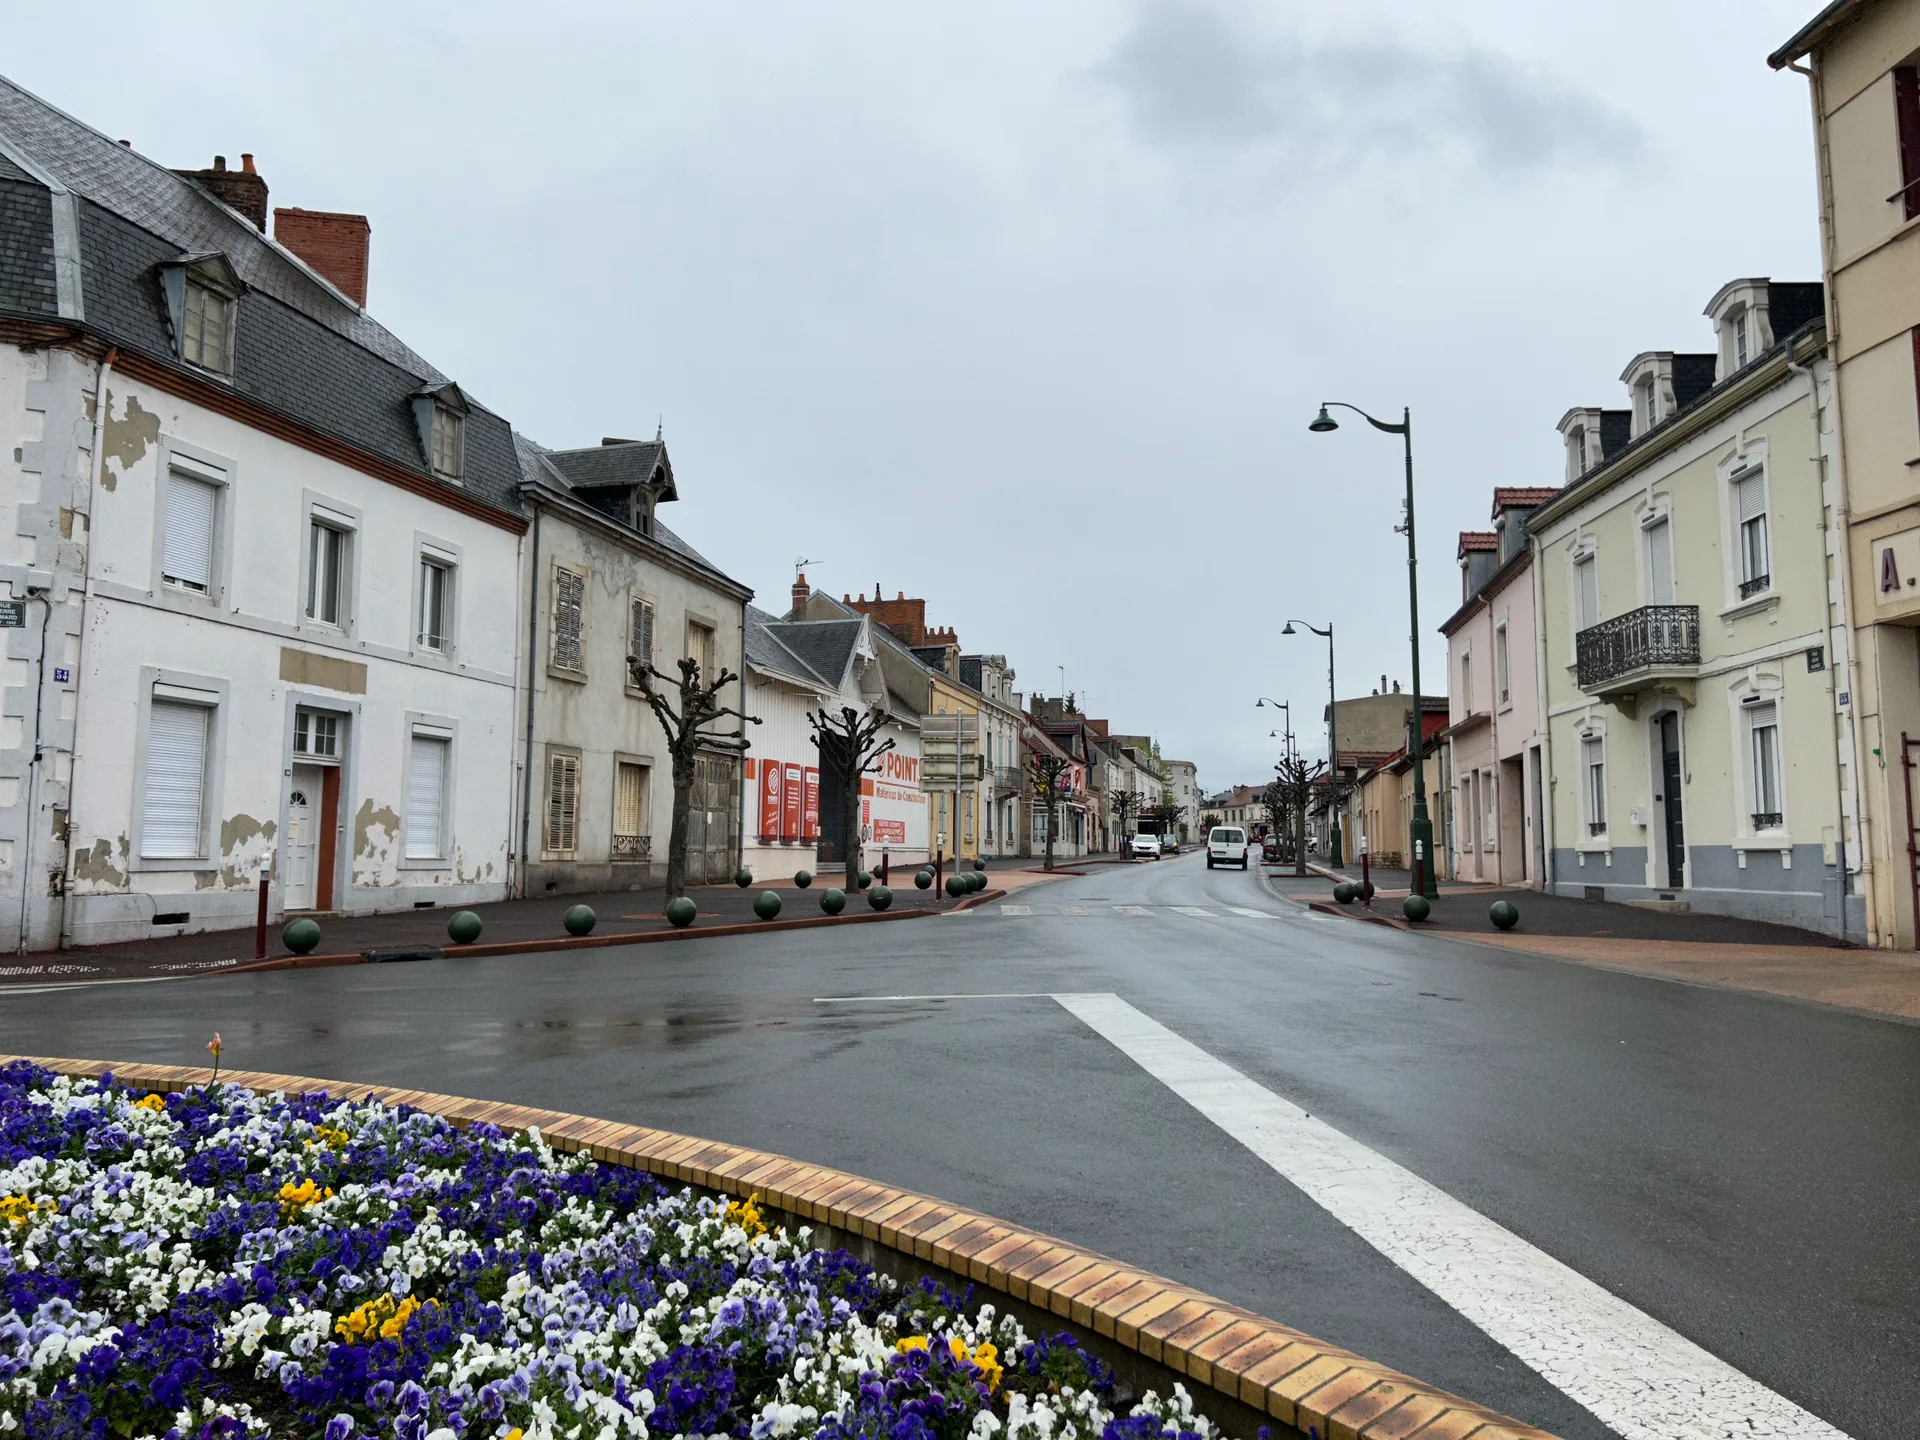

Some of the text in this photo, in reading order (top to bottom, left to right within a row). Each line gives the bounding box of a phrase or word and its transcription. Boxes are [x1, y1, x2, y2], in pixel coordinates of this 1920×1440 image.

[56, 670, 68, 680] 54
[887, 752, 920, 782] POINT.
[897, 791, 902, 800] de
